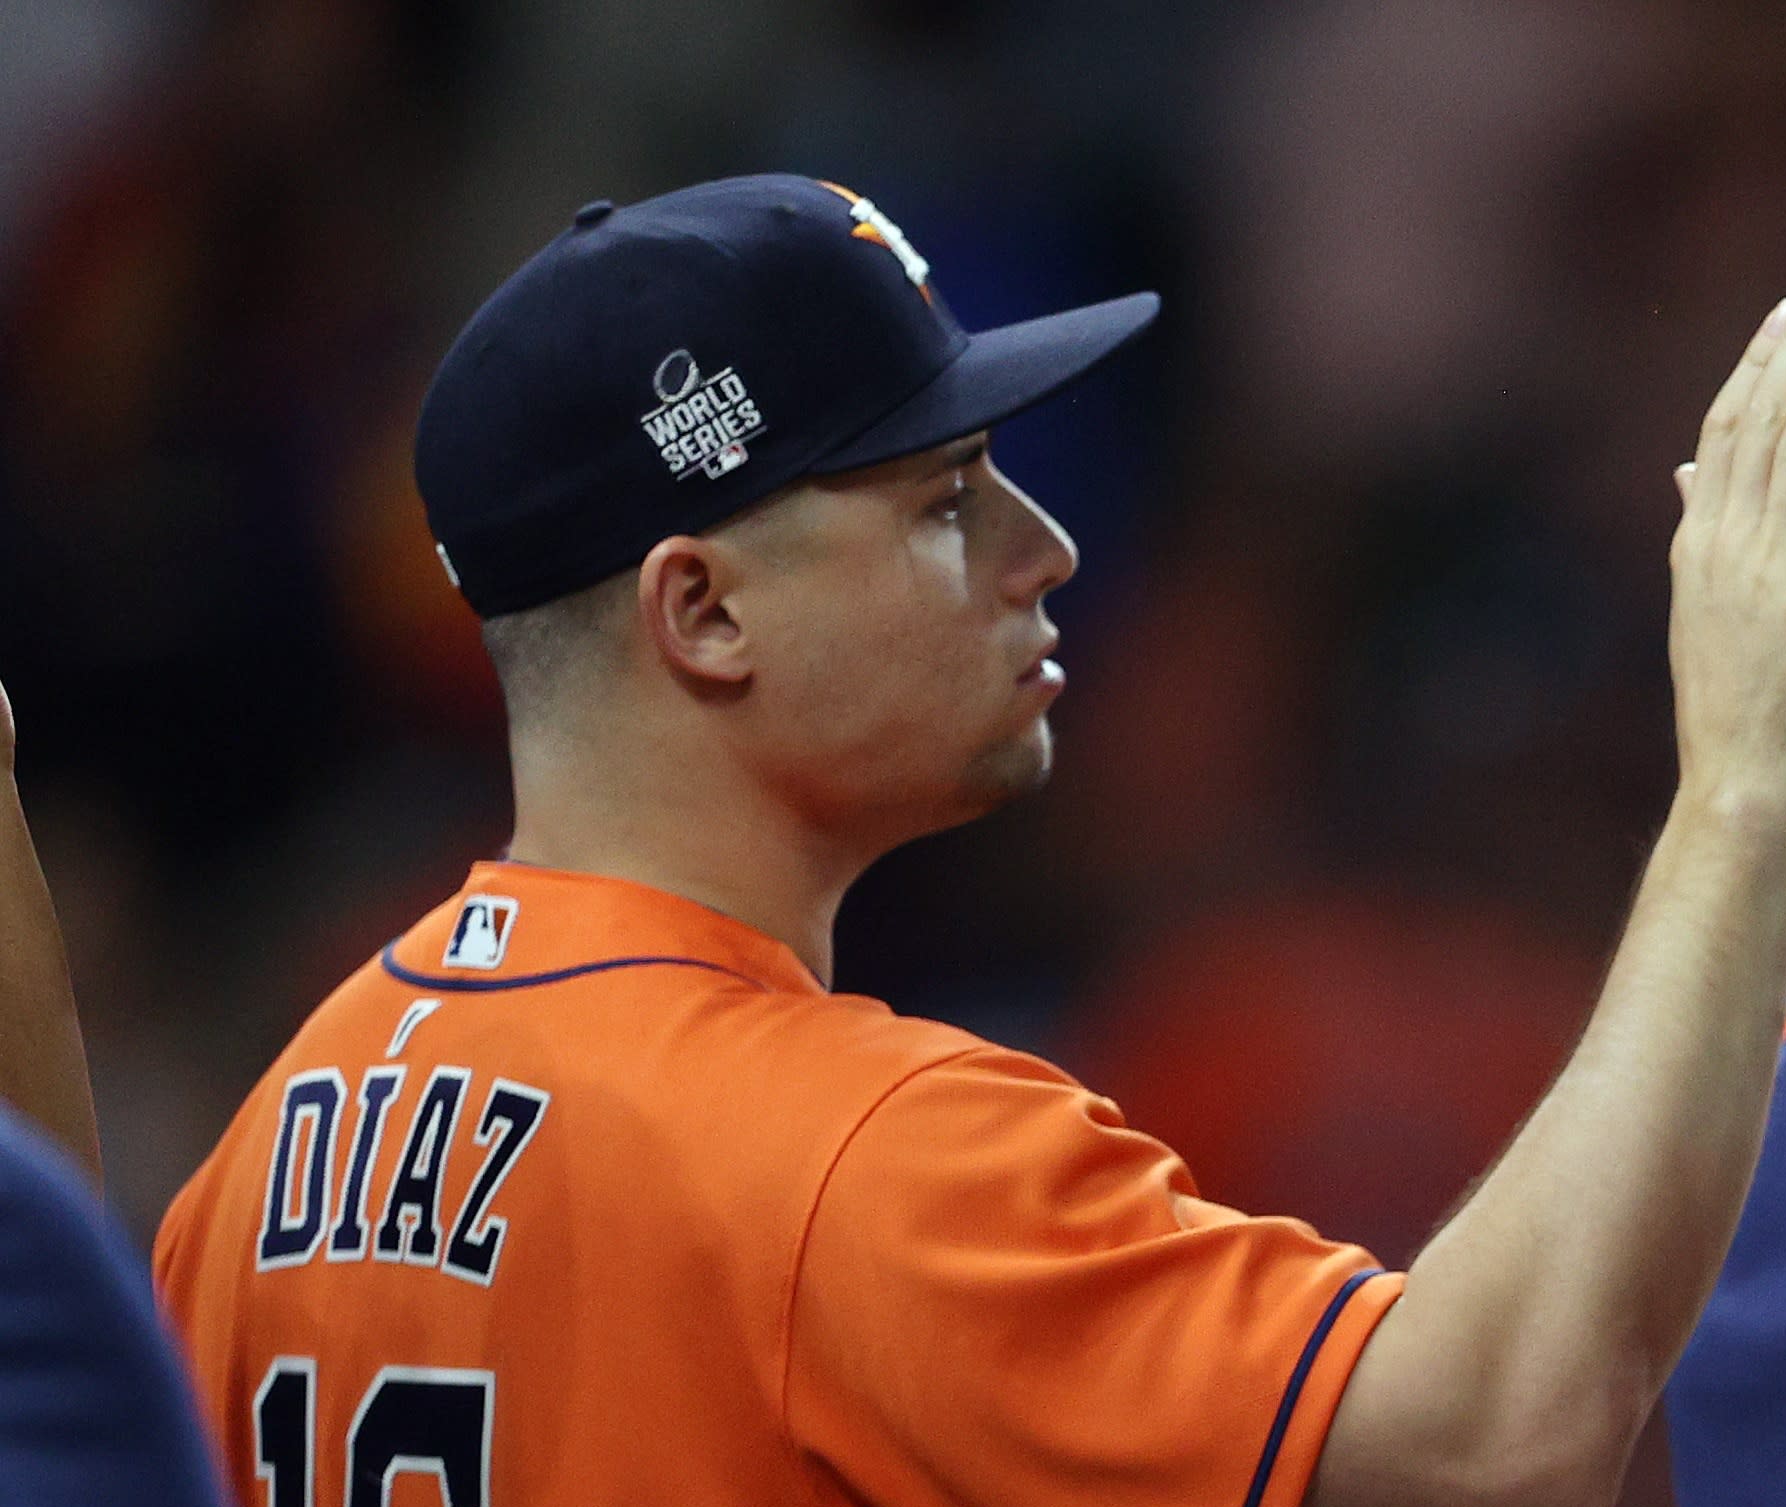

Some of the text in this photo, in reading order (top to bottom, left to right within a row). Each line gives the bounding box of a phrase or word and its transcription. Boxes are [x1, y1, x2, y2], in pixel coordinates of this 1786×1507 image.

[643, 373, 748, 447] WORLD
[660, 398, 762, 473] SERIES
[255, 1000, 551, 1287] DÍAZ
